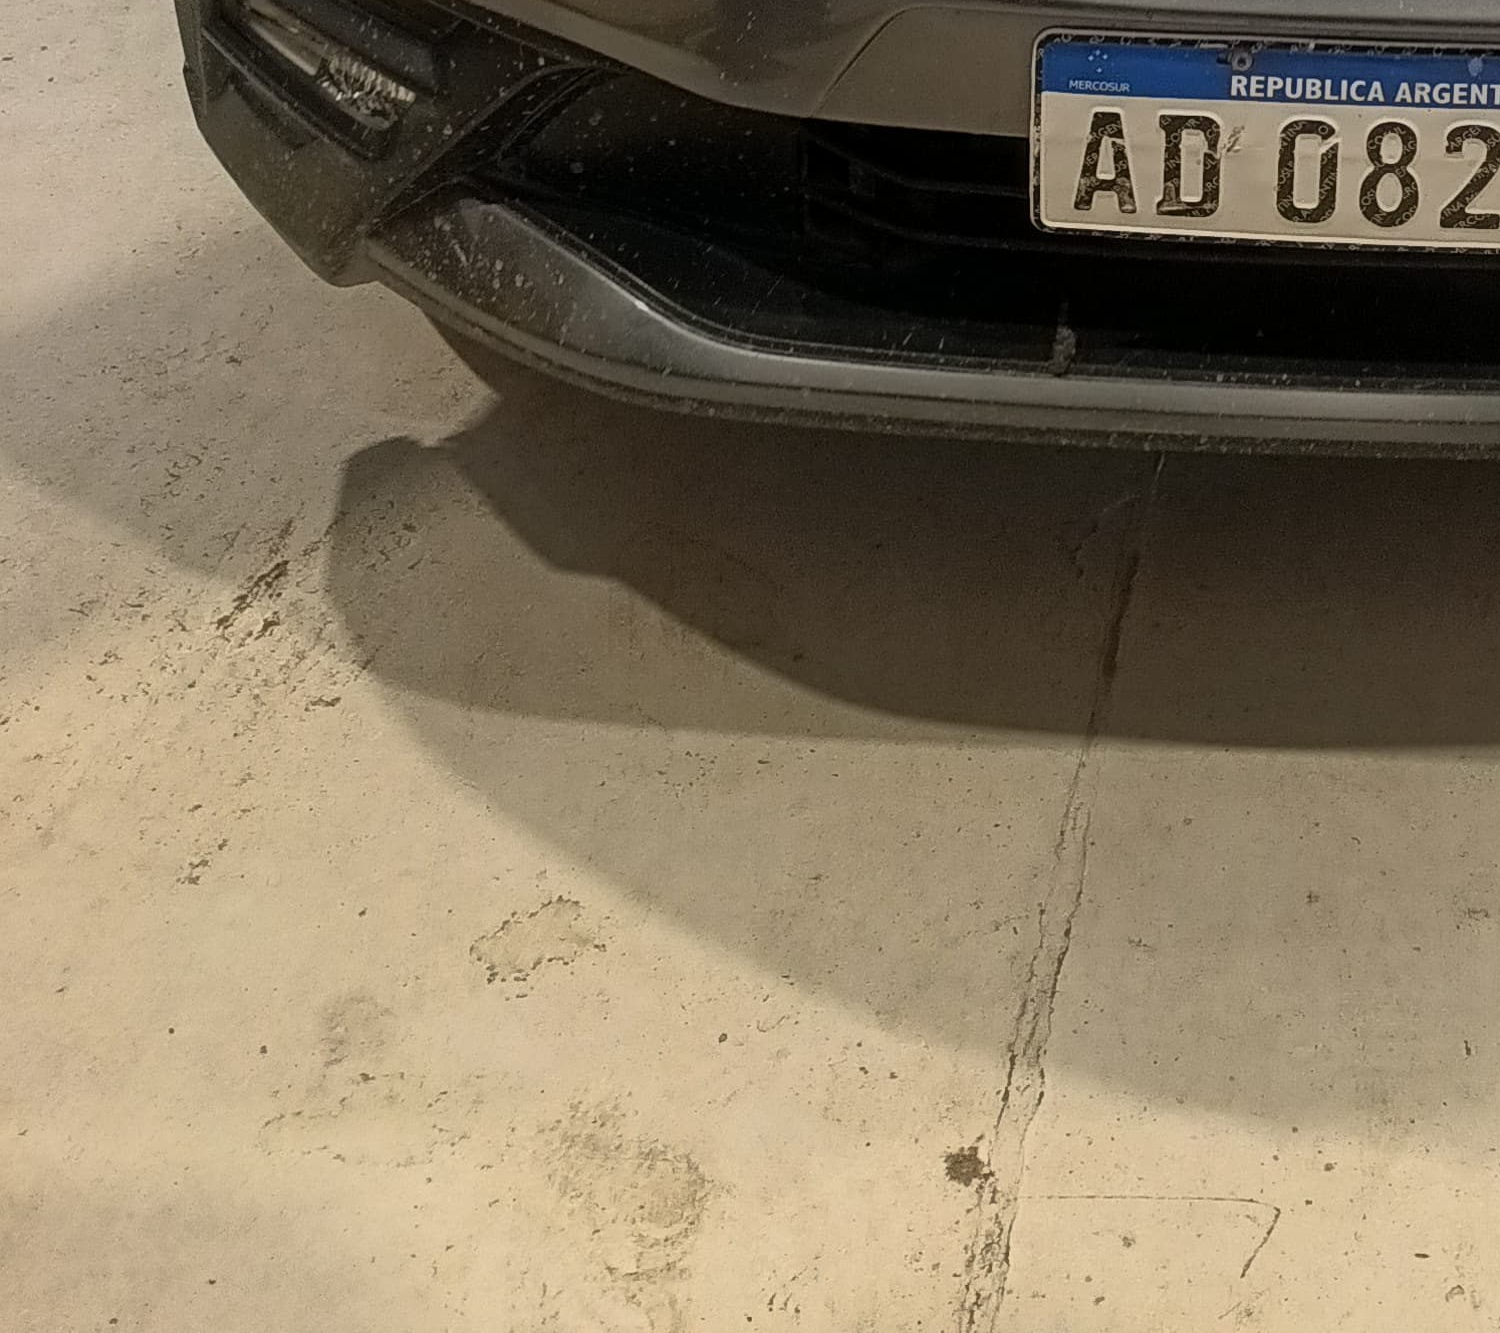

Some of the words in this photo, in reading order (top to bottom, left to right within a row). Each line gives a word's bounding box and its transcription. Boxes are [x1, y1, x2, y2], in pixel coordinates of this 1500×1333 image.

[1068, 79, 1131, 93] MERCOSUR
[1230, 74, 1386, 102] REPUBLICA
[1073, 111, 1222, 218] AD
